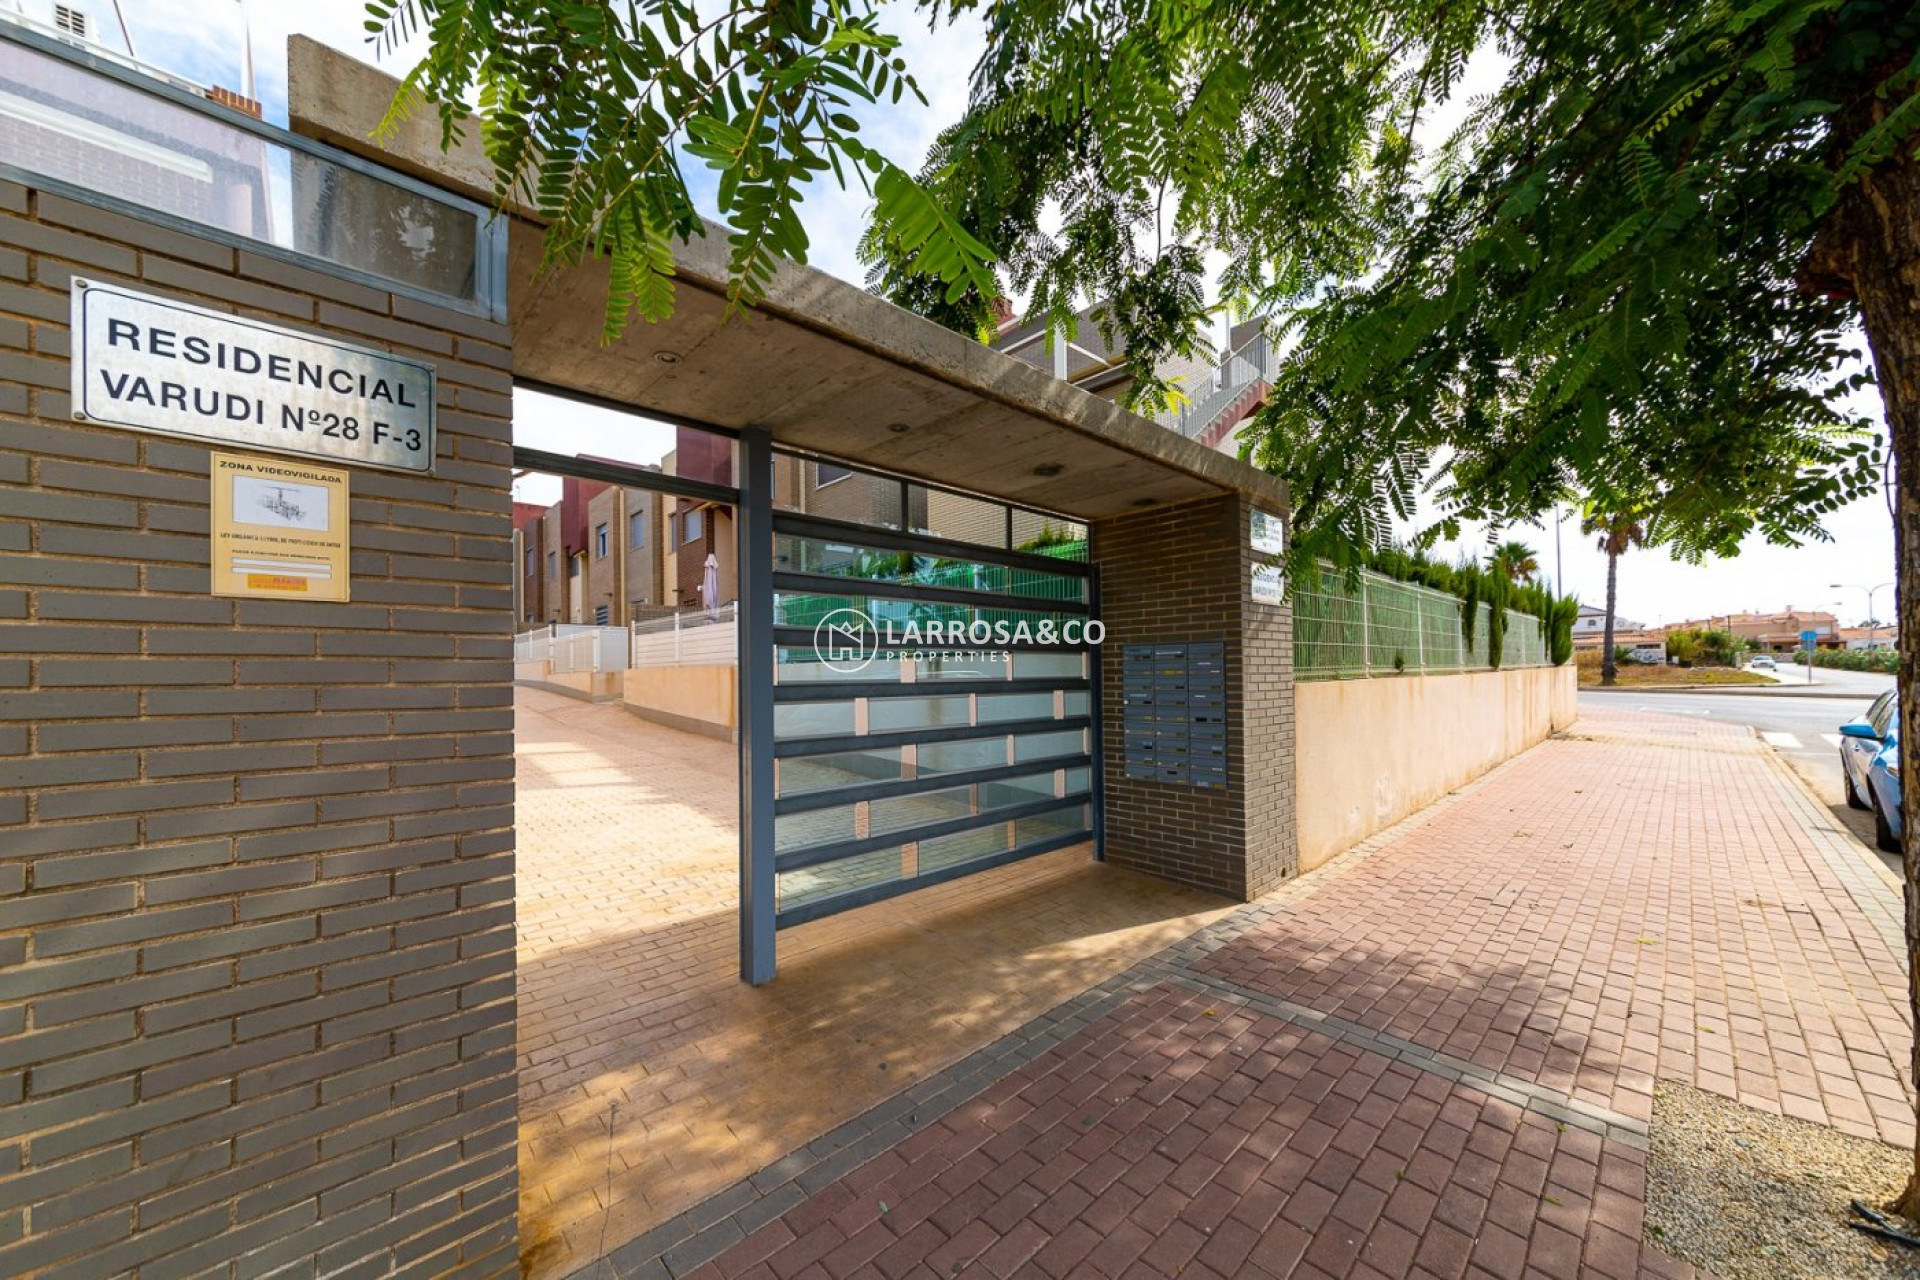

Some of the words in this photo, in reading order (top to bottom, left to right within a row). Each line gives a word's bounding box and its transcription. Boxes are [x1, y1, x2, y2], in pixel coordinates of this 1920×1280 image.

[108, 317, 417, 408] RESIDENCIAL
[100, 368, 264, 425] VARUDI
[281, 404, 360, 441] Nº28
[373, 422, 422, 452] F-3
[219, 460, 254, 472] ZONA
[256, 466, 342, 484] VIDEOVIGILADA
